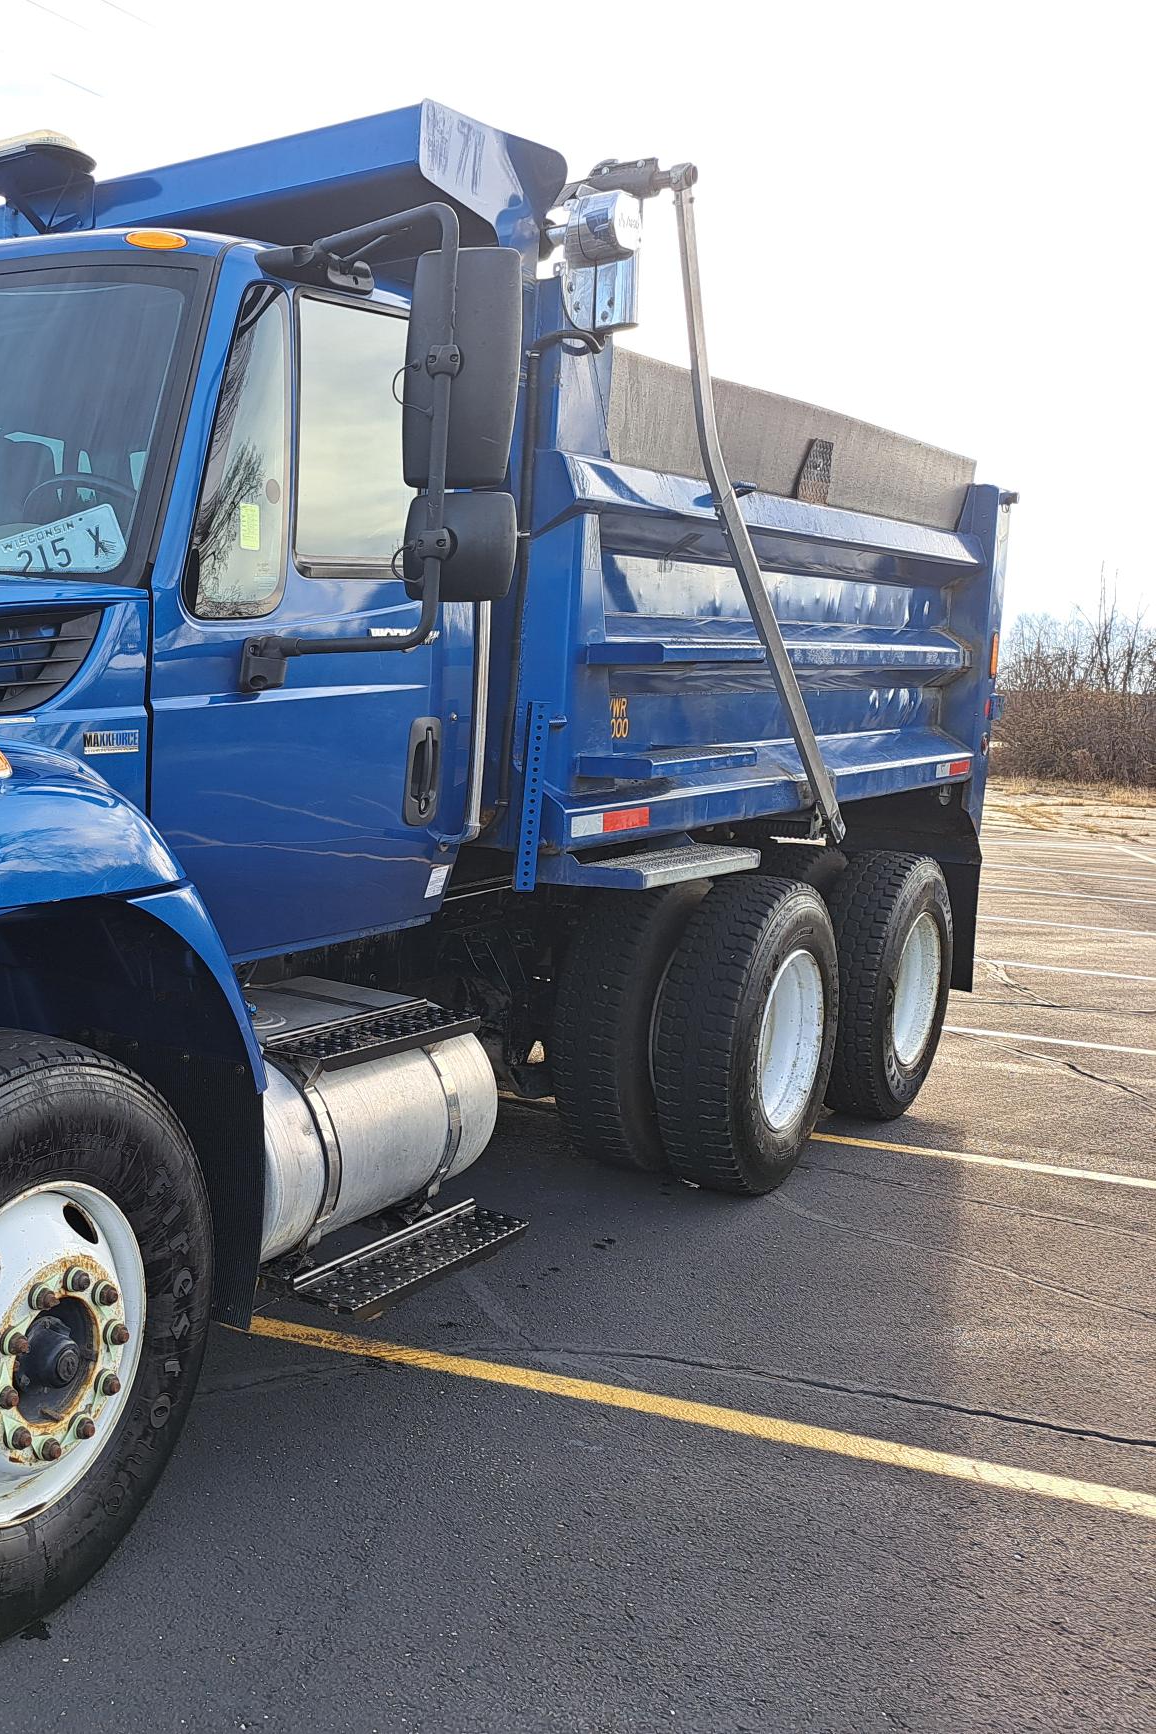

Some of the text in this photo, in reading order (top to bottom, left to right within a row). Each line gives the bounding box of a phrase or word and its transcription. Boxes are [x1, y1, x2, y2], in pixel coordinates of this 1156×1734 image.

[1, 520, 75, 554] WISCONSIN
[16, 536, 73, 573] 215
[85, 524, 109, 558] X
[83, 731, 139, 748] MAXXFORCE
